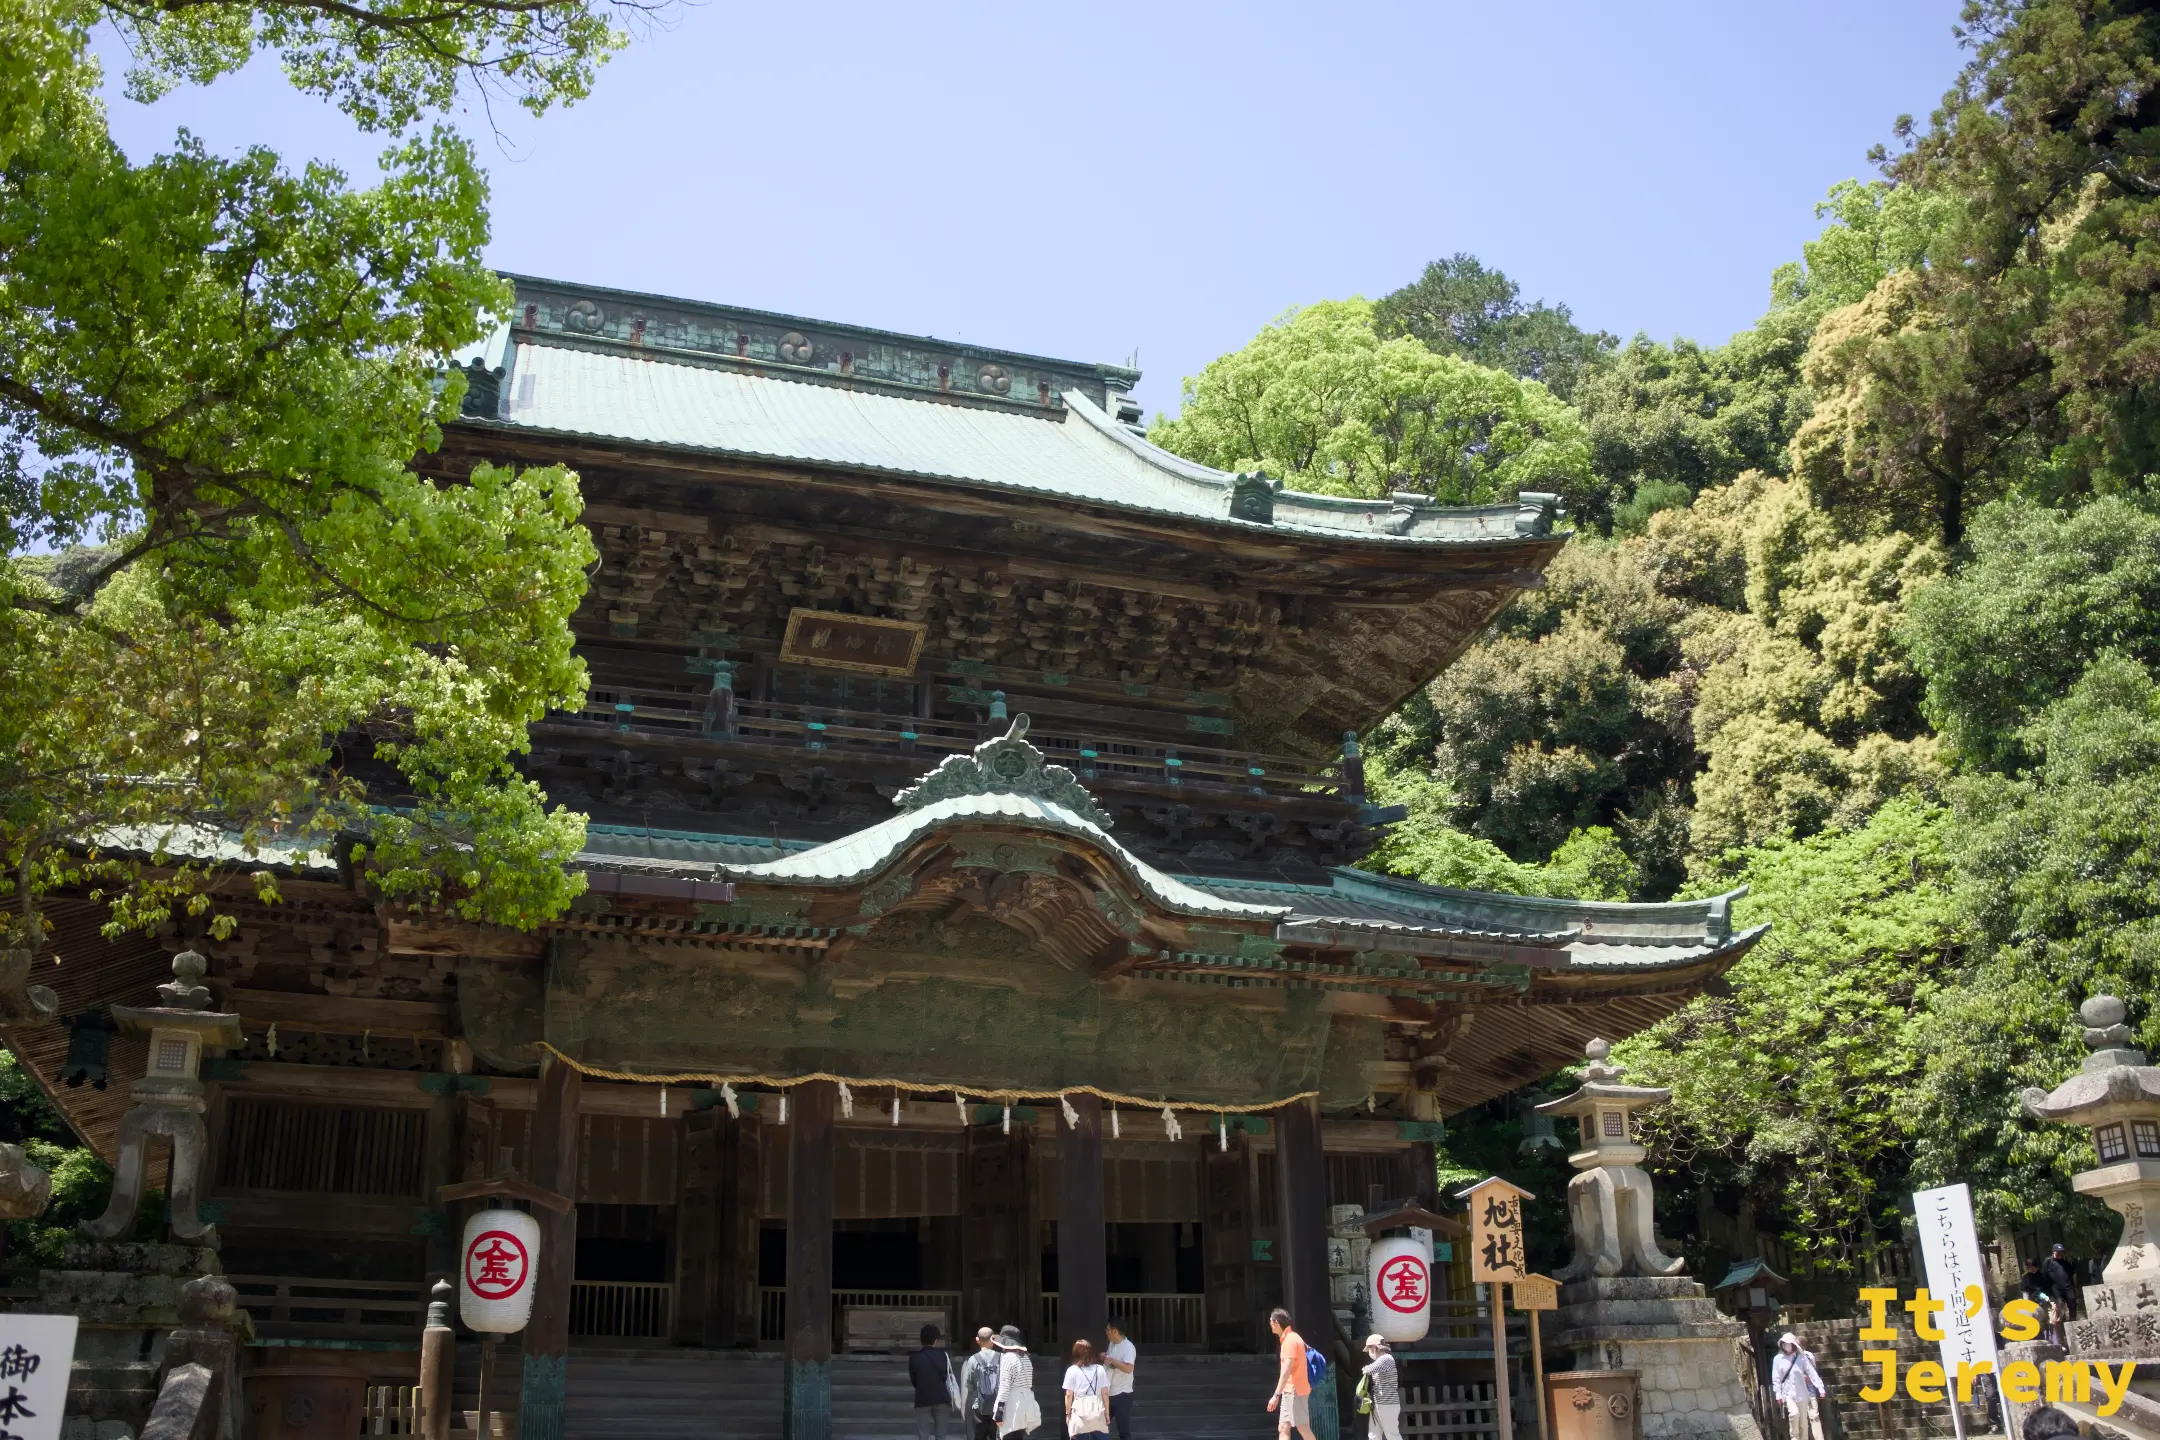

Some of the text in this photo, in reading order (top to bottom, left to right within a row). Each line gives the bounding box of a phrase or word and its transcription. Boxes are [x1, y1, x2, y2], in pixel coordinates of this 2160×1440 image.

[1481, 1196, 1517, 1271] 旭社
[1935, 1196, 1977, 1365] こちらは下向道です
